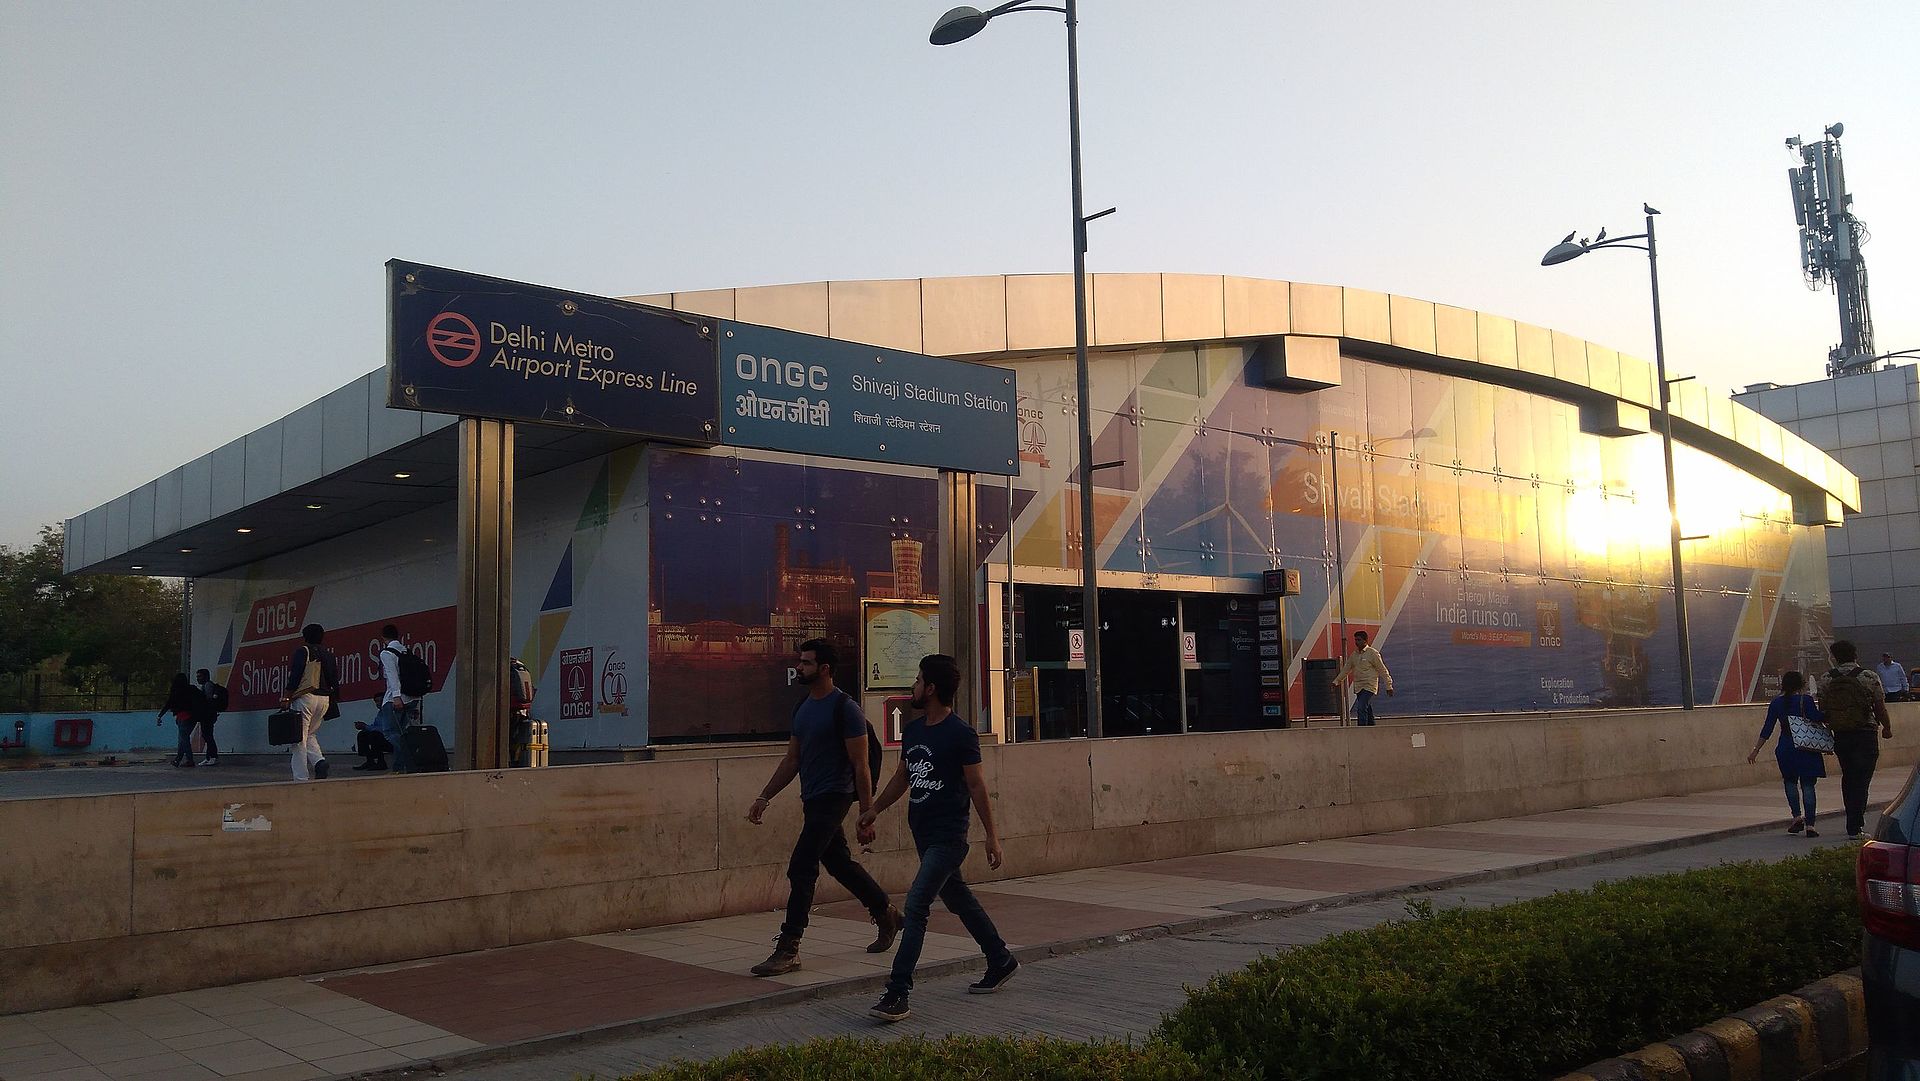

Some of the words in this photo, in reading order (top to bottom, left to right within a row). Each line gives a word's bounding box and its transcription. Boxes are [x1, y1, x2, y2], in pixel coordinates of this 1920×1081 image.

[490, 321, 545, 351] Delhi
[554, 332, 614, 361] Metro
[489, 348, 571, 379] Airport
[577, 359, 654, 390] Express
[660, 370, 697, 395] Line
[852, 375, 900, 399] Shivaji
[904, 382, 960, 406] Stadium
[963, 391, 1009, 413] Station
[735, 390, 831, 427] ओएनजीसी
[853, 411, 882, 426] शिवाजी
[885, 416, 915, 431] स्टेडियम
[918, 420, 942, 434] स्टेशन
[1457, 588, 1486, 606] Energy
[1488, 591, 1512, 608] Major.
[1436, 601, 1467, 624] India
[1472, 609, 1499, 627] runs
[1503, 611, 1522, 628] on.
[241, 655, 290, 697] Shivaji
[1541, 677, 1574, 690] Exploration
[1559, 693, 1590, 705] Production
[910, 772, 945, 791] Jones
